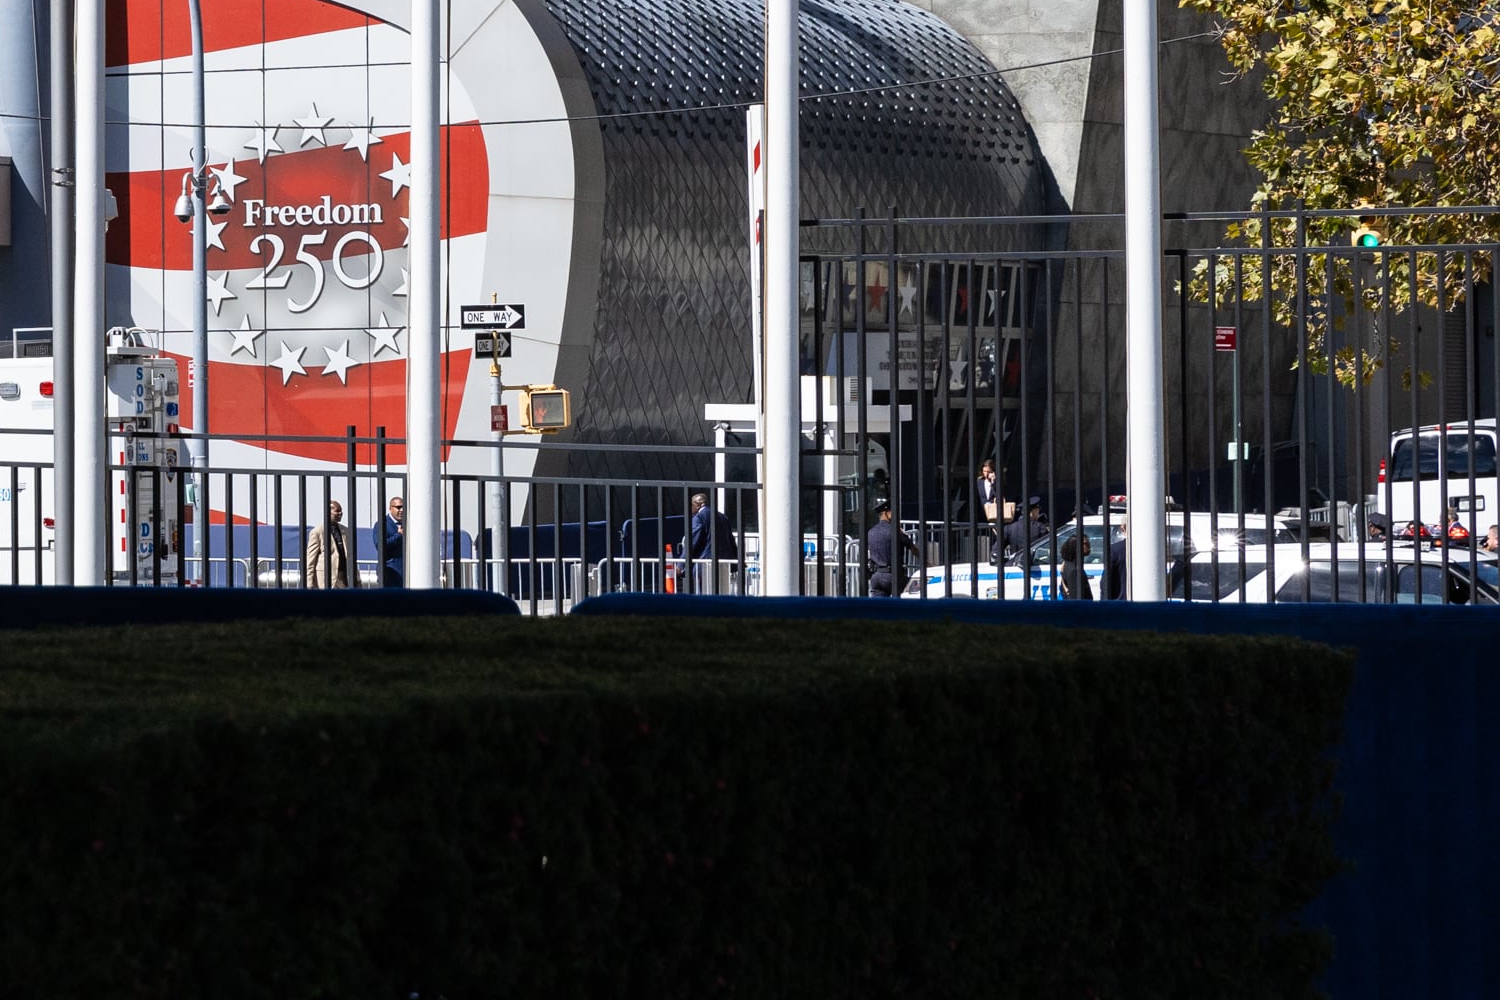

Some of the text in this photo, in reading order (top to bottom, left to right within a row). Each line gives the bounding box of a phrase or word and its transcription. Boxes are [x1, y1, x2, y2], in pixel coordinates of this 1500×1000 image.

[243, 195, 384, 227] Freedom
[245, 229, 384, 313] 250
[467, 311, 512, 322] ONE WAY
